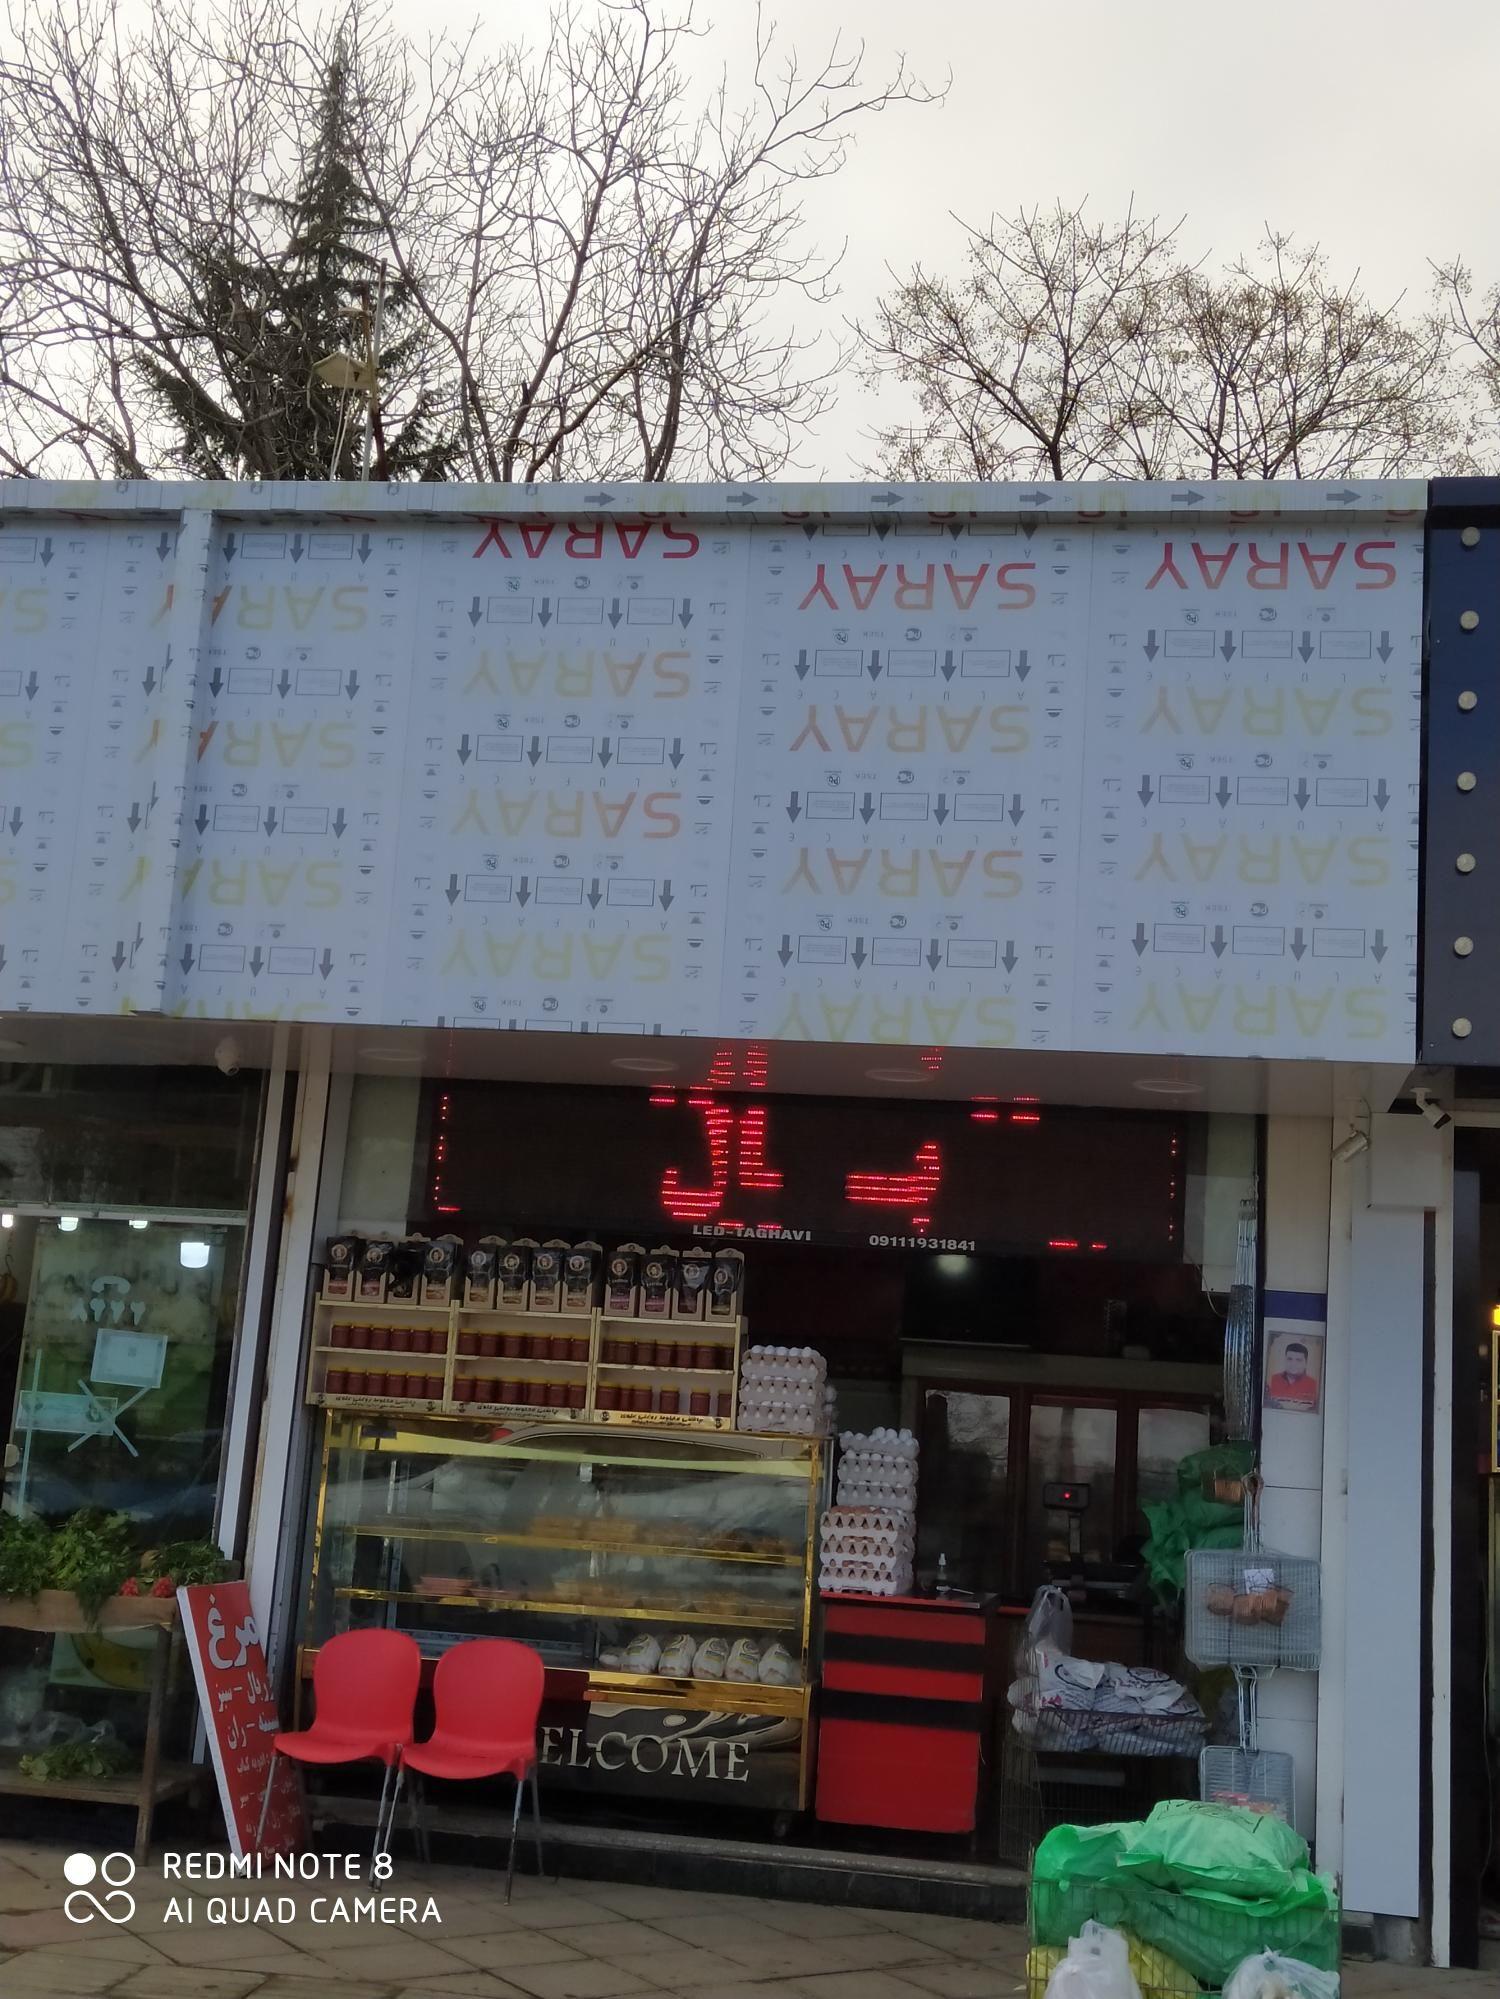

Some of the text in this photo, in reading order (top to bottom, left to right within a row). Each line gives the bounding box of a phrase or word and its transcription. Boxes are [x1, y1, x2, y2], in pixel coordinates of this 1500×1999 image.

[472, 521, 699, 560] SARAY
[798, 563, 1036, 610] SARAY
[1145, 542, 1396, 589] SARAY
[462, 650, 691, 700] SARAY
[790, 705, 1030, 752] SARAY
[1139, 687, 1392, 736] SARAY
[450, 790, 682, 839] SARAY
[781, 848, 1023, 899] SARAY
[1133, 832, 1391, 887] SARAY
[439, 929, 672, 982] SARAY
[775, 992, 1016, 1046] SARAY
[1129, 983, 1388, 1039] SARAY
[692, 1225, 976, 1251] LED-TAGHAVI 09111931841
[208, 1593, 260, 1669] مرغ
